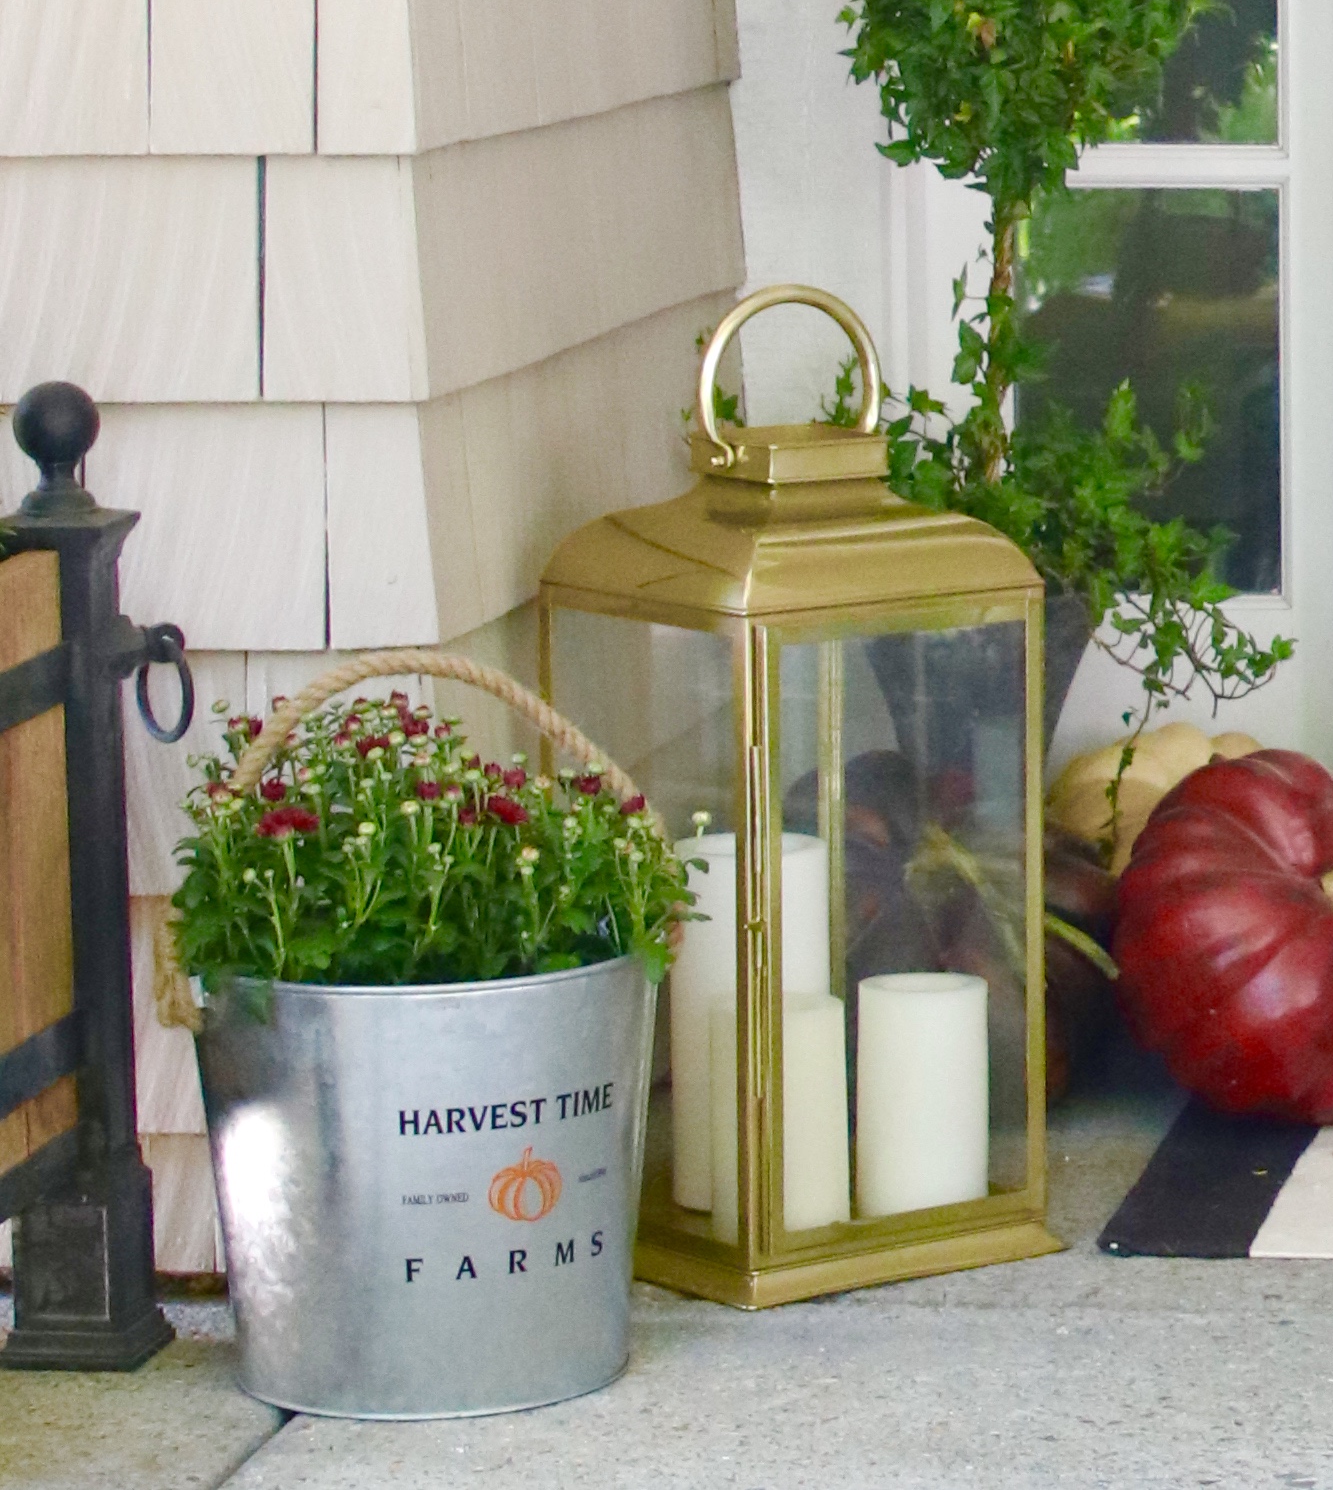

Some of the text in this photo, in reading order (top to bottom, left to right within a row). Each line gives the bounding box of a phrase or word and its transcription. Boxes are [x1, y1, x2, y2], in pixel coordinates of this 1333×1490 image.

[398, 1082, 614, 1136] HARVEST TIME
[405, 1230, 604, 1283] FARMS
